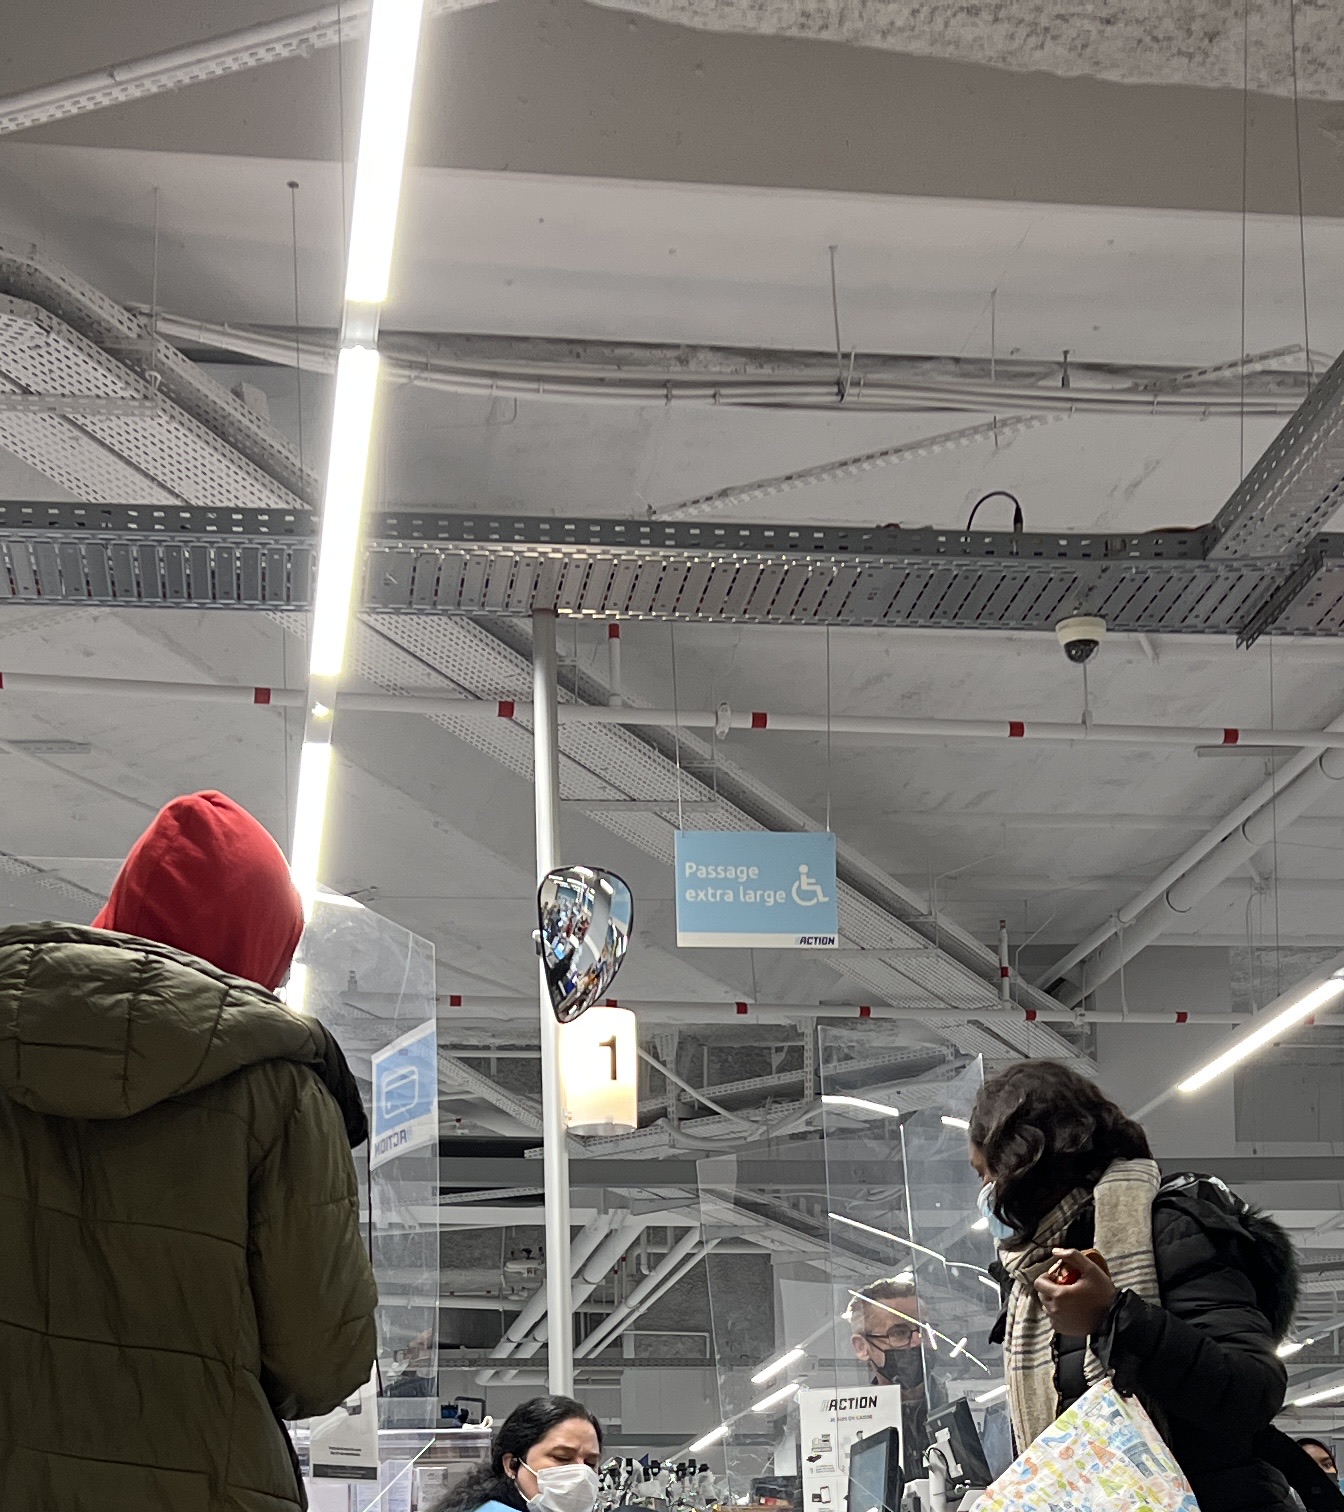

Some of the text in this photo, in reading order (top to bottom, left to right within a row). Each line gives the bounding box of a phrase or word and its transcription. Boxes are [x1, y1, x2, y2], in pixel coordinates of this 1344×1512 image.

[685, 862, 759, 882] Passage
[685, 886, 786, 906] extra large
[799, 936, 835, 945] ACTION
[598, 1035, 618, 1080] 1
[828, 1396, 878, 1411] ACTION
